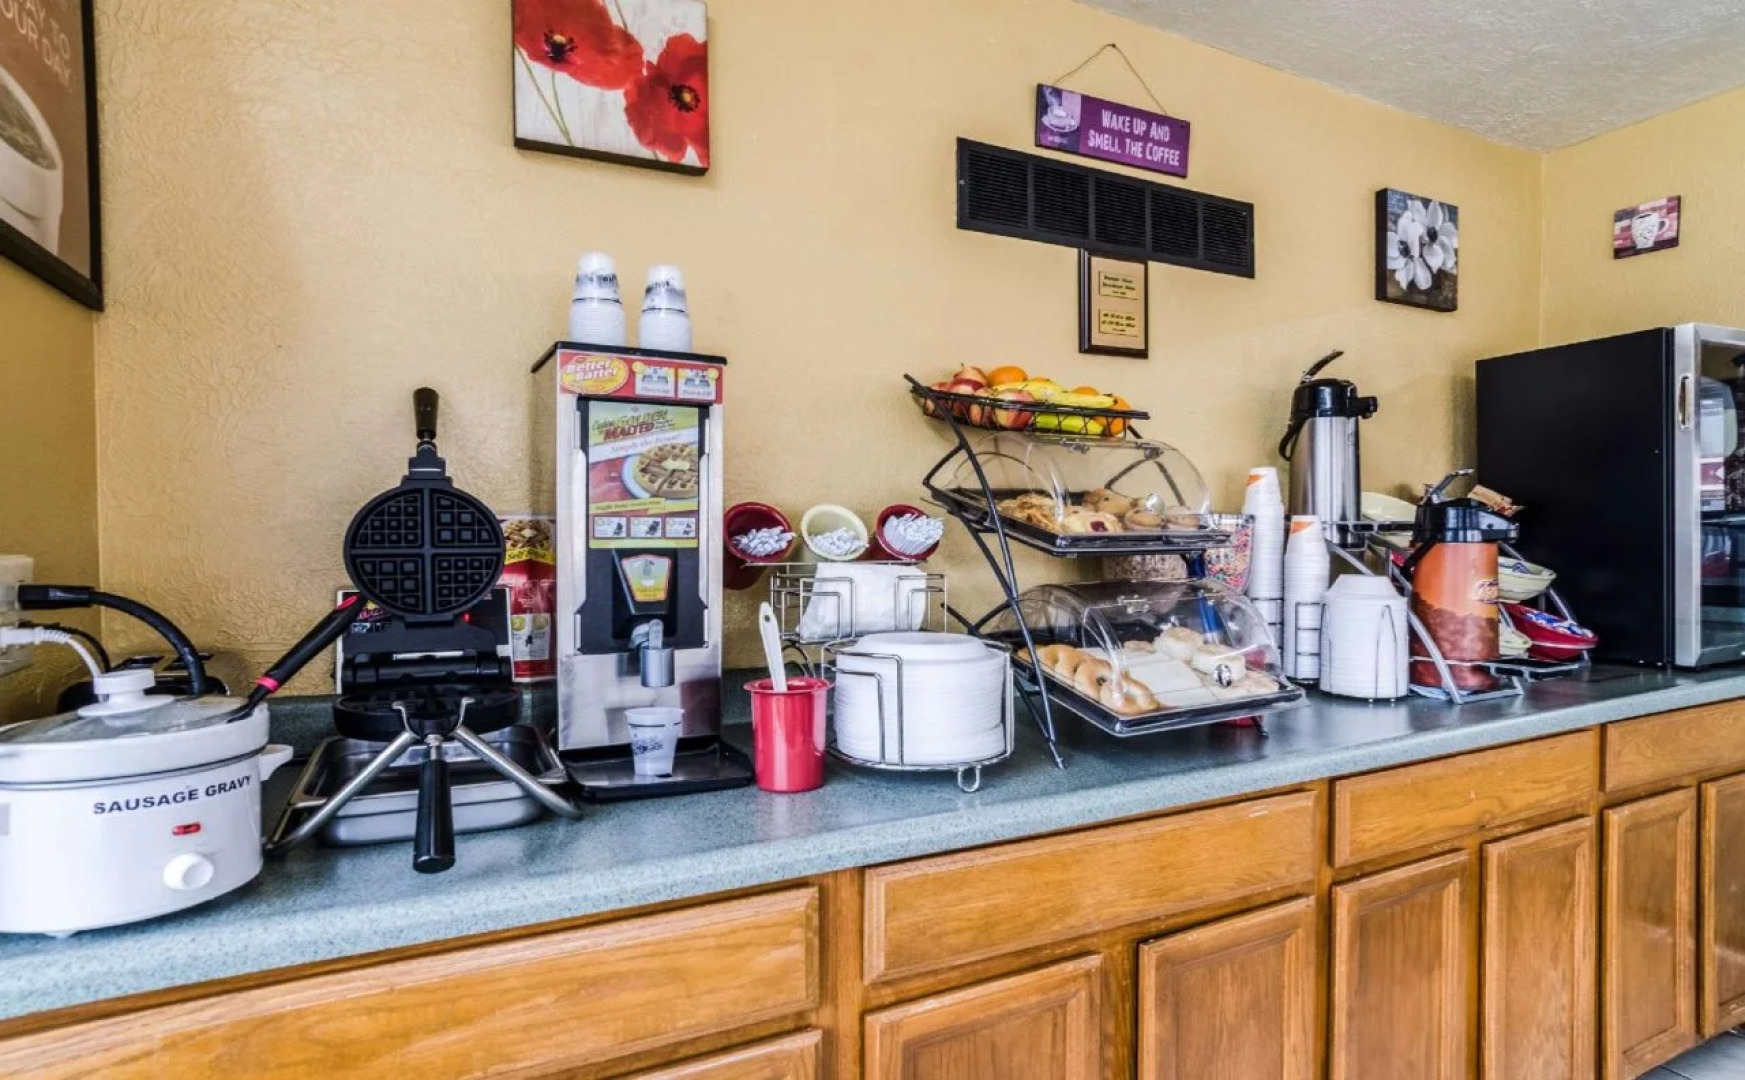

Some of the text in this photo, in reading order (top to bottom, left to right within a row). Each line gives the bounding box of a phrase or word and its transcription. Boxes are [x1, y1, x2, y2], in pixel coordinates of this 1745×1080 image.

[1101, 108, 1171, 143] WAKE UP AND
[1088, 130, 1180, 166] SMELL THE COFFEE
[603, 423, 655, 441] MALTED
[93, 774, 251, 815] SAUSAGE GRAVY
